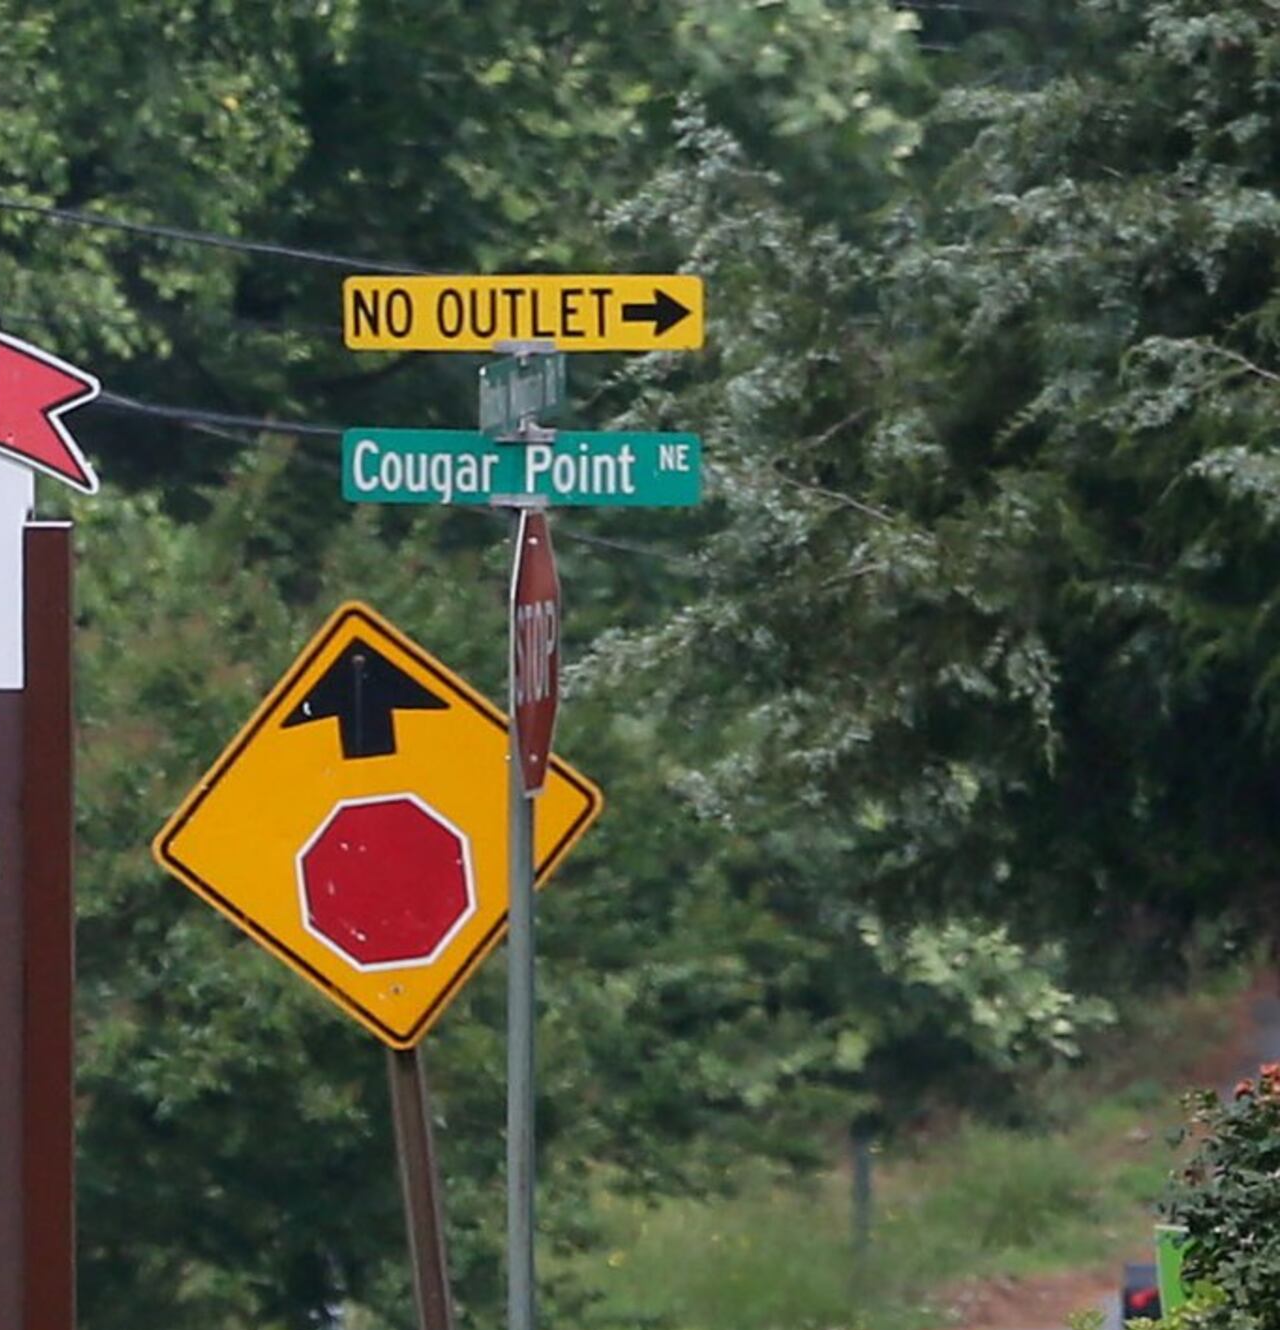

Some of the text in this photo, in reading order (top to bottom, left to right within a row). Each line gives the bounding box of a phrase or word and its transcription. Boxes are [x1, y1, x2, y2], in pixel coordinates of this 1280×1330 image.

[352, 288, 613, 339] NO OUTLET
[352, 439, 690, 505] Cougar Point NE
[517, 600, 556, 704] STOP
